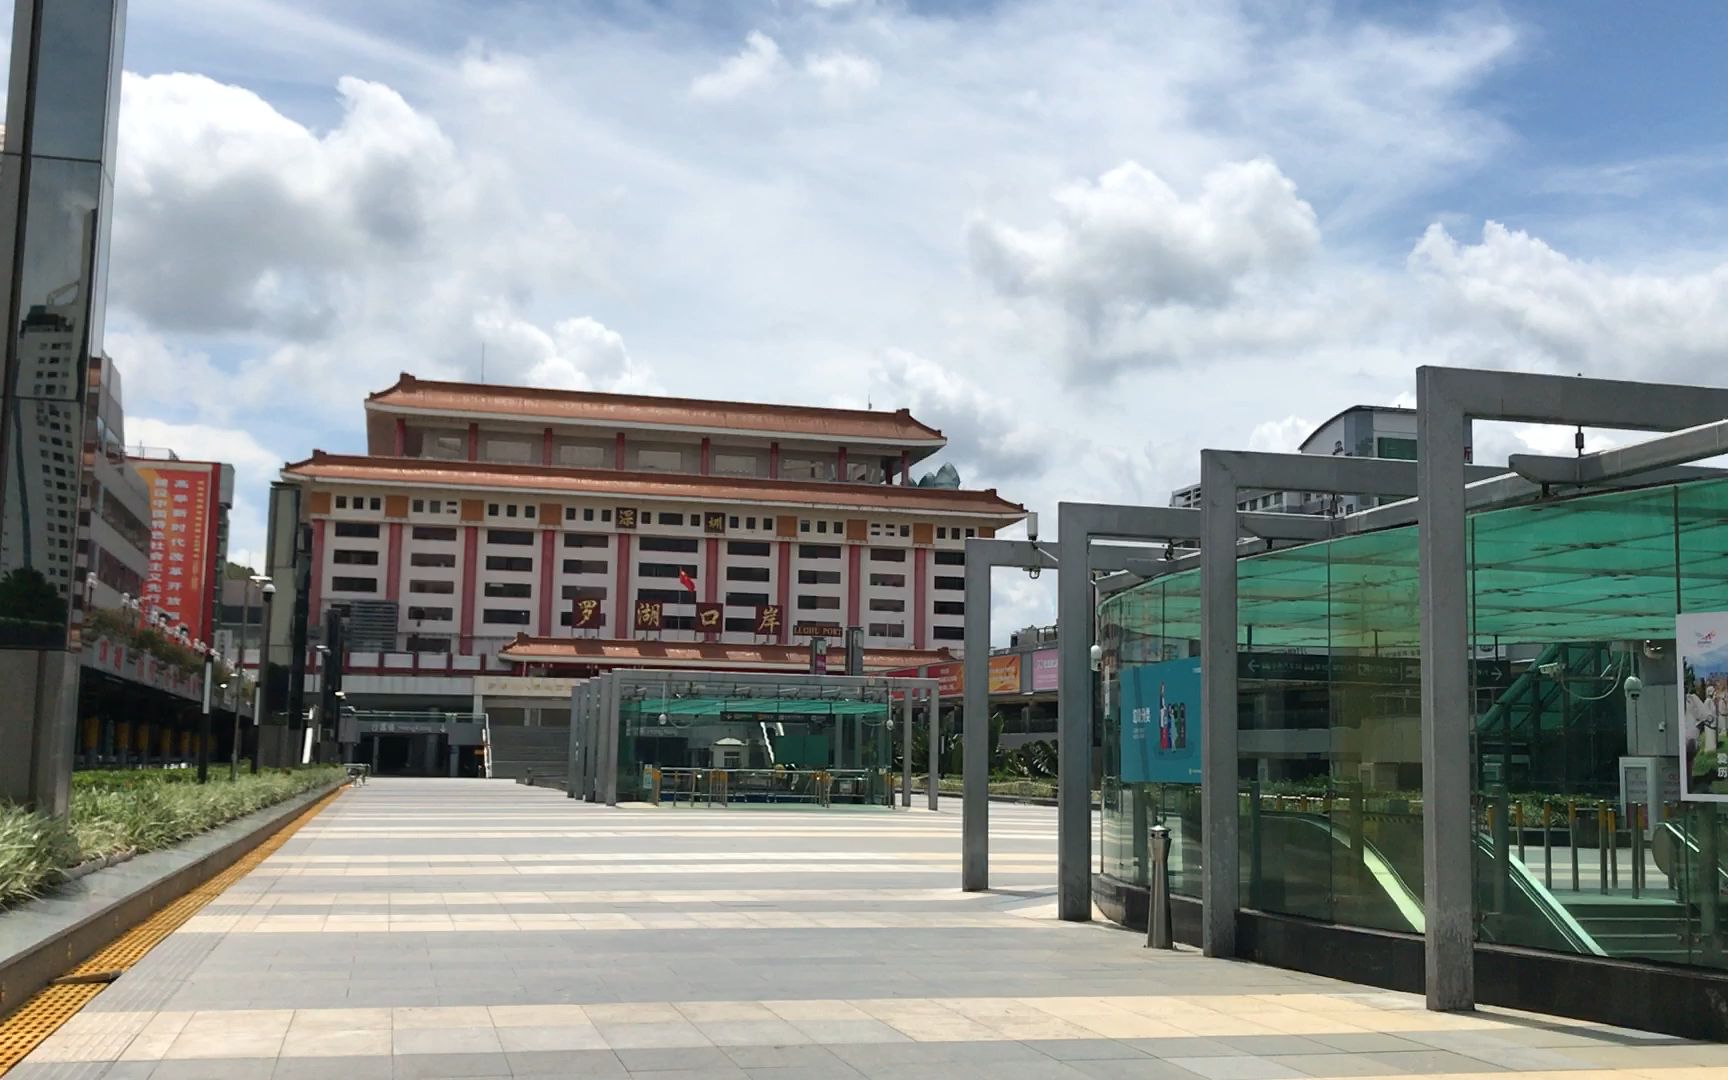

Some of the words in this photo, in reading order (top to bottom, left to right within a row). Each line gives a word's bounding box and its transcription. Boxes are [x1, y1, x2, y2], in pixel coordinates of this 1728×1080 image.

[577, 600, 779, 631] 罗湖口岸
[822, 628, 841, 636] PORT
